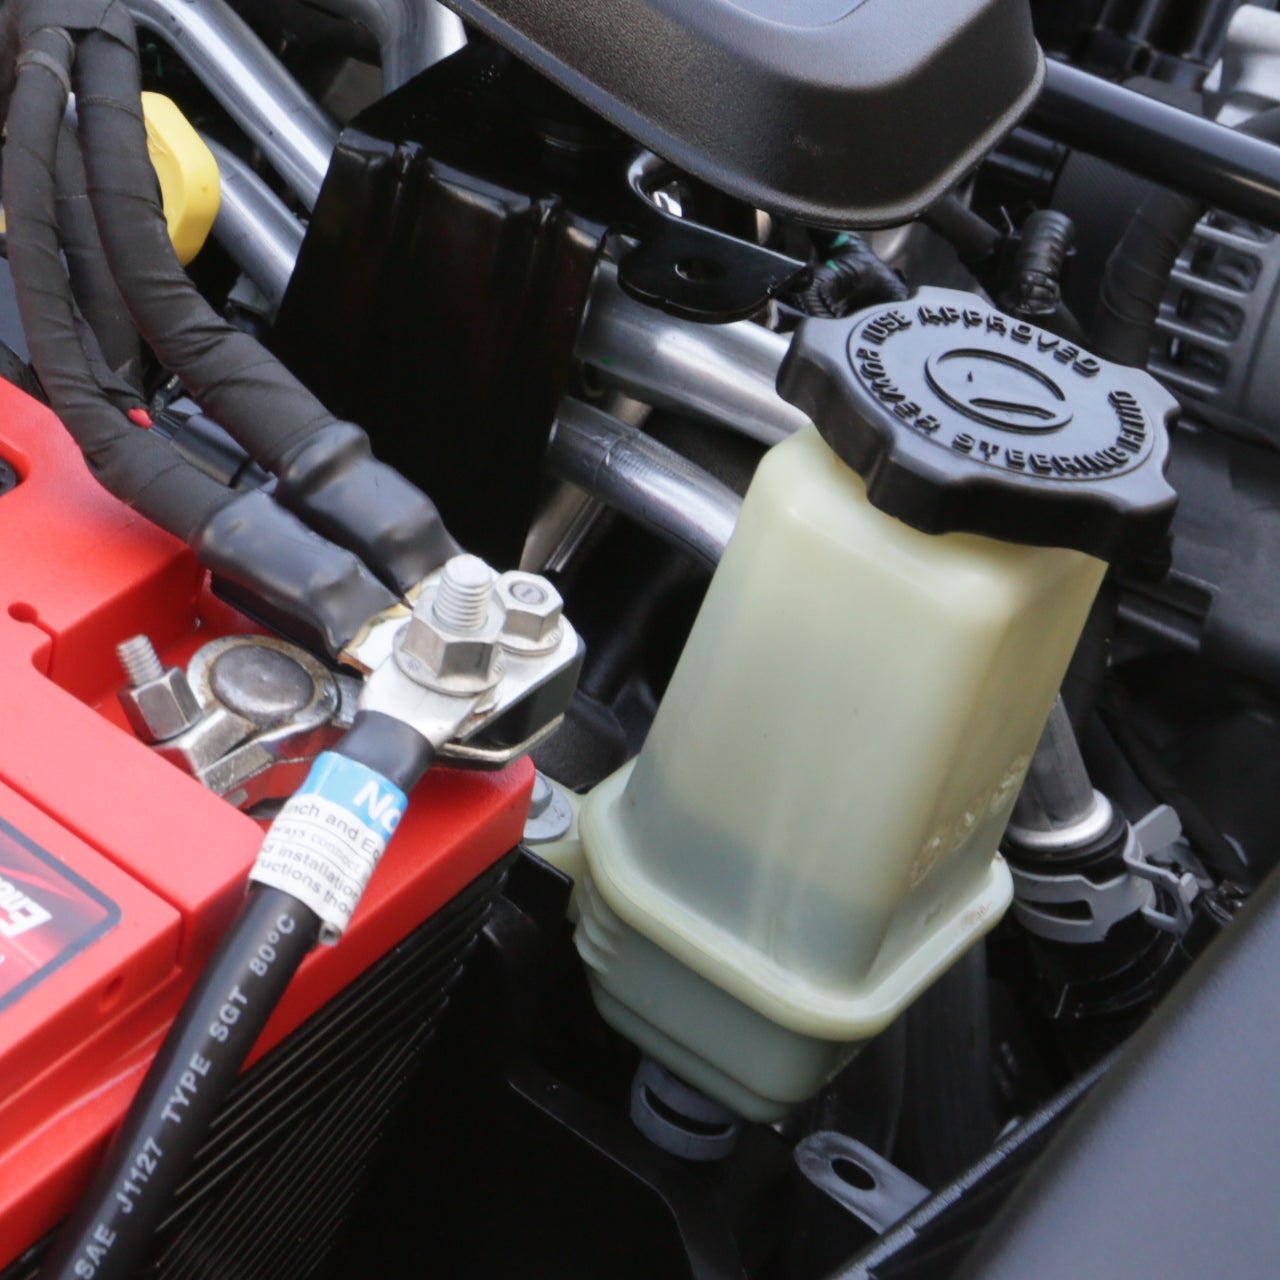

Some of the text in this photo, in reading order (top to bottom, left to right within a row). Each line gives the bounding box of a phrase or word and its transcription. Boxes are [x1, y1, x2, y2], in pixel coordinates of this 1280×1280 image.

[917, 305, 1101, 378] APPROVED
[856, 347, 1130, 477] POWER STEERING
[325, 811, 360, 841] and
[74, 913, 297, 1280] SAE J1127 TYPE SGT 80°C
